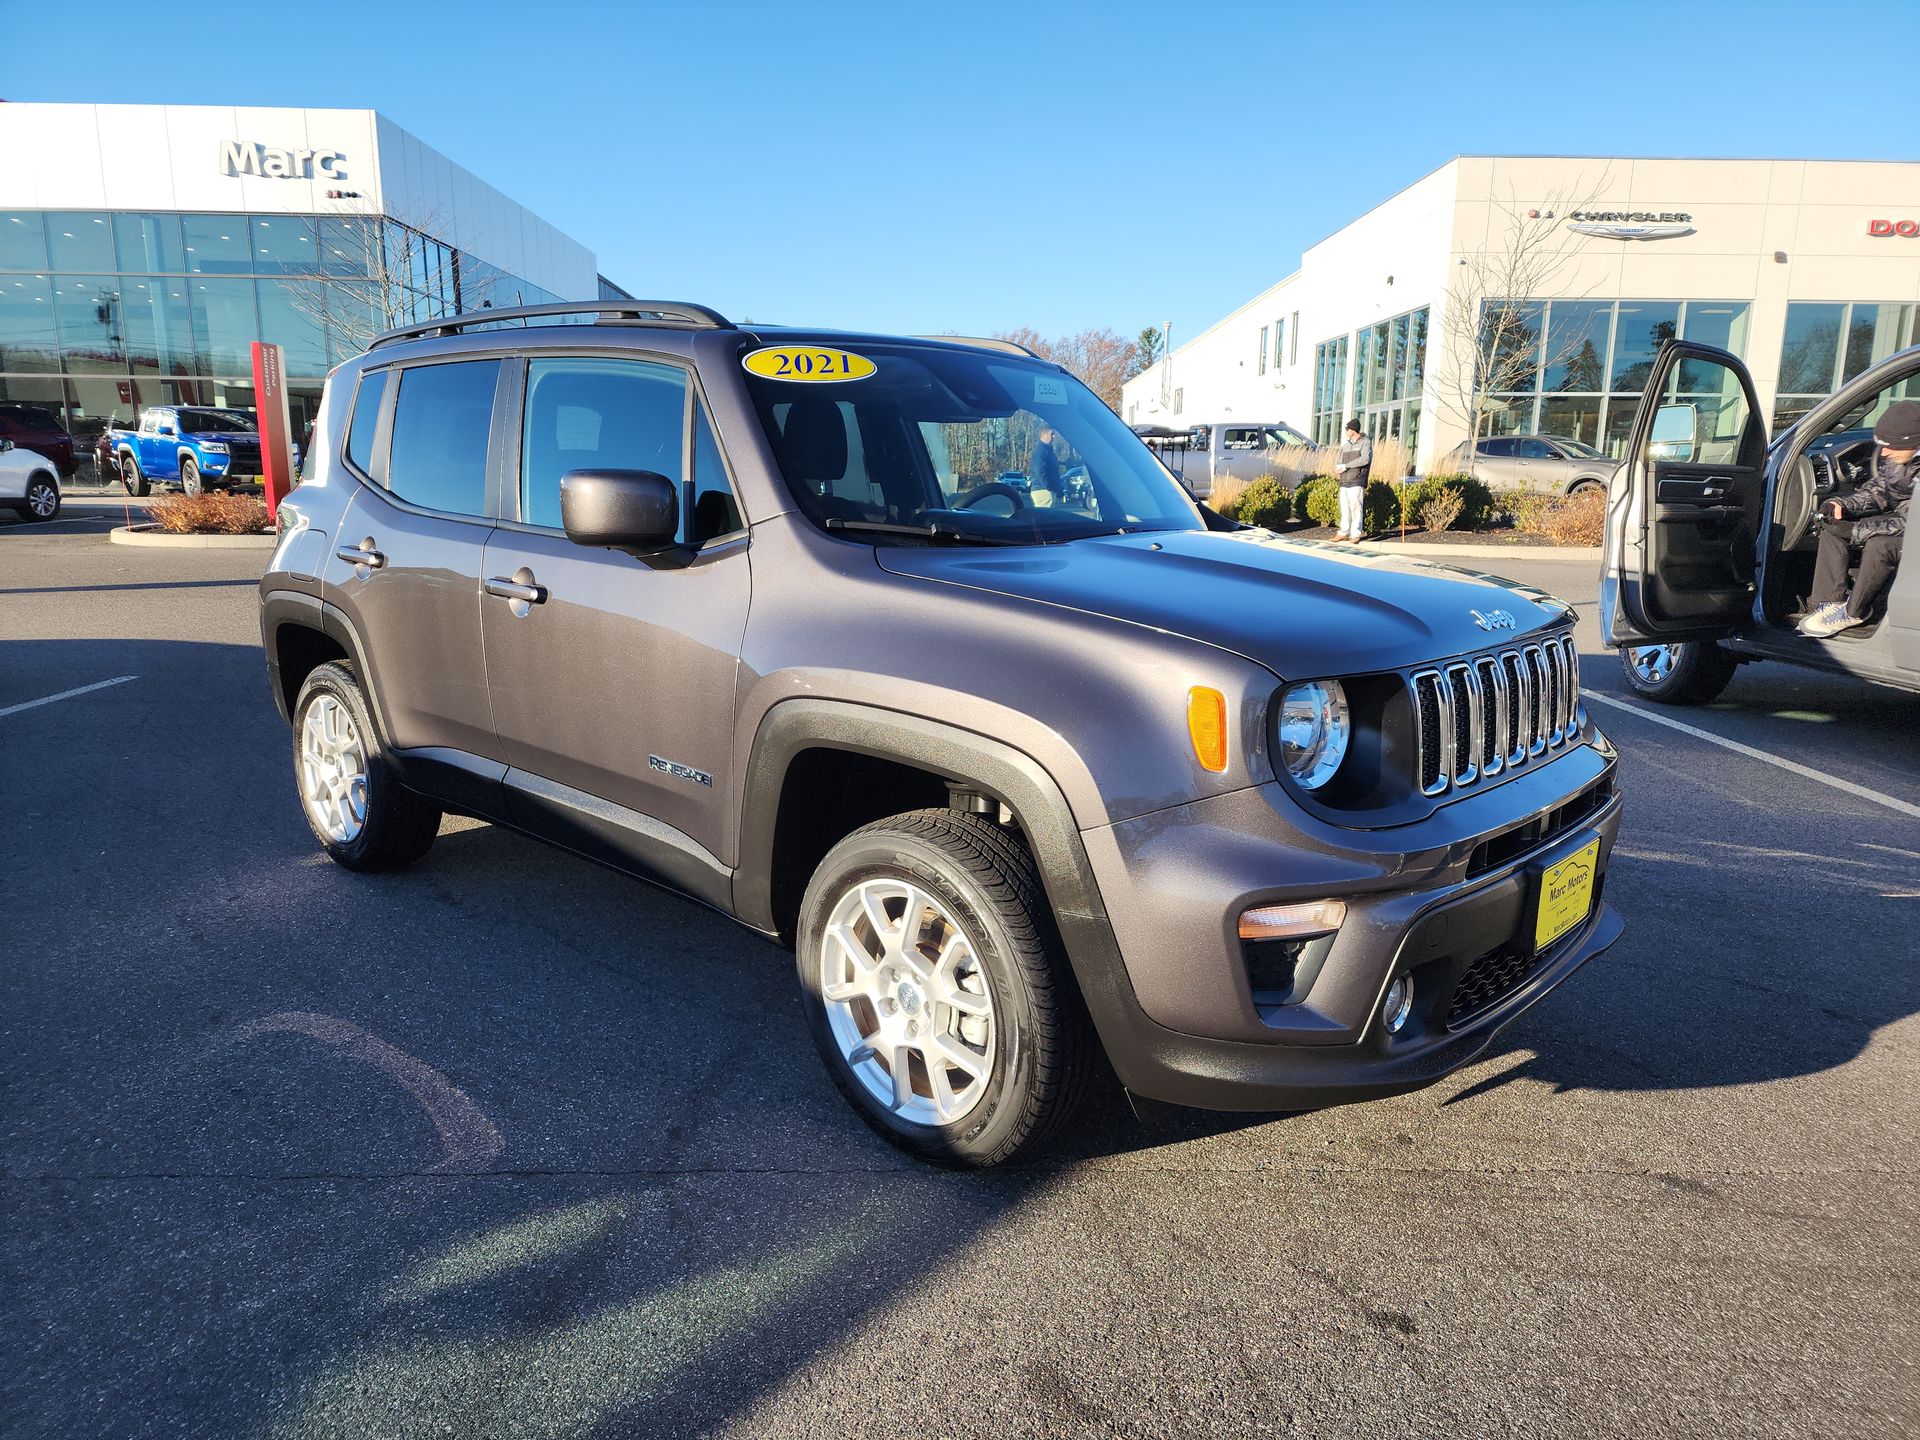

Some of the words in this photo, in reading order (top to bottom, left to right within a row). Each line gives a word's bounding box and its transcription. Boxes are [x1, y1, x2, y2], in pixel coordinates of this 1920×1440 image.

[219, 140, 348, 180] Marc
[1569, 211, 1692, 223] CHRYSLER
[1867, 219, 1920, 238] DO
[262, 346, 270, 396] Customer
[269, 348, 277, 387] Parking
[772, 353, 853, 375] 2021
[1470, 609, 1516, 632] Jeep
[648, 754, 713, 788] RENEGADE
[1549, 884, 1567, 903] Marc
[1567, 870, 1588, 891] Motors
